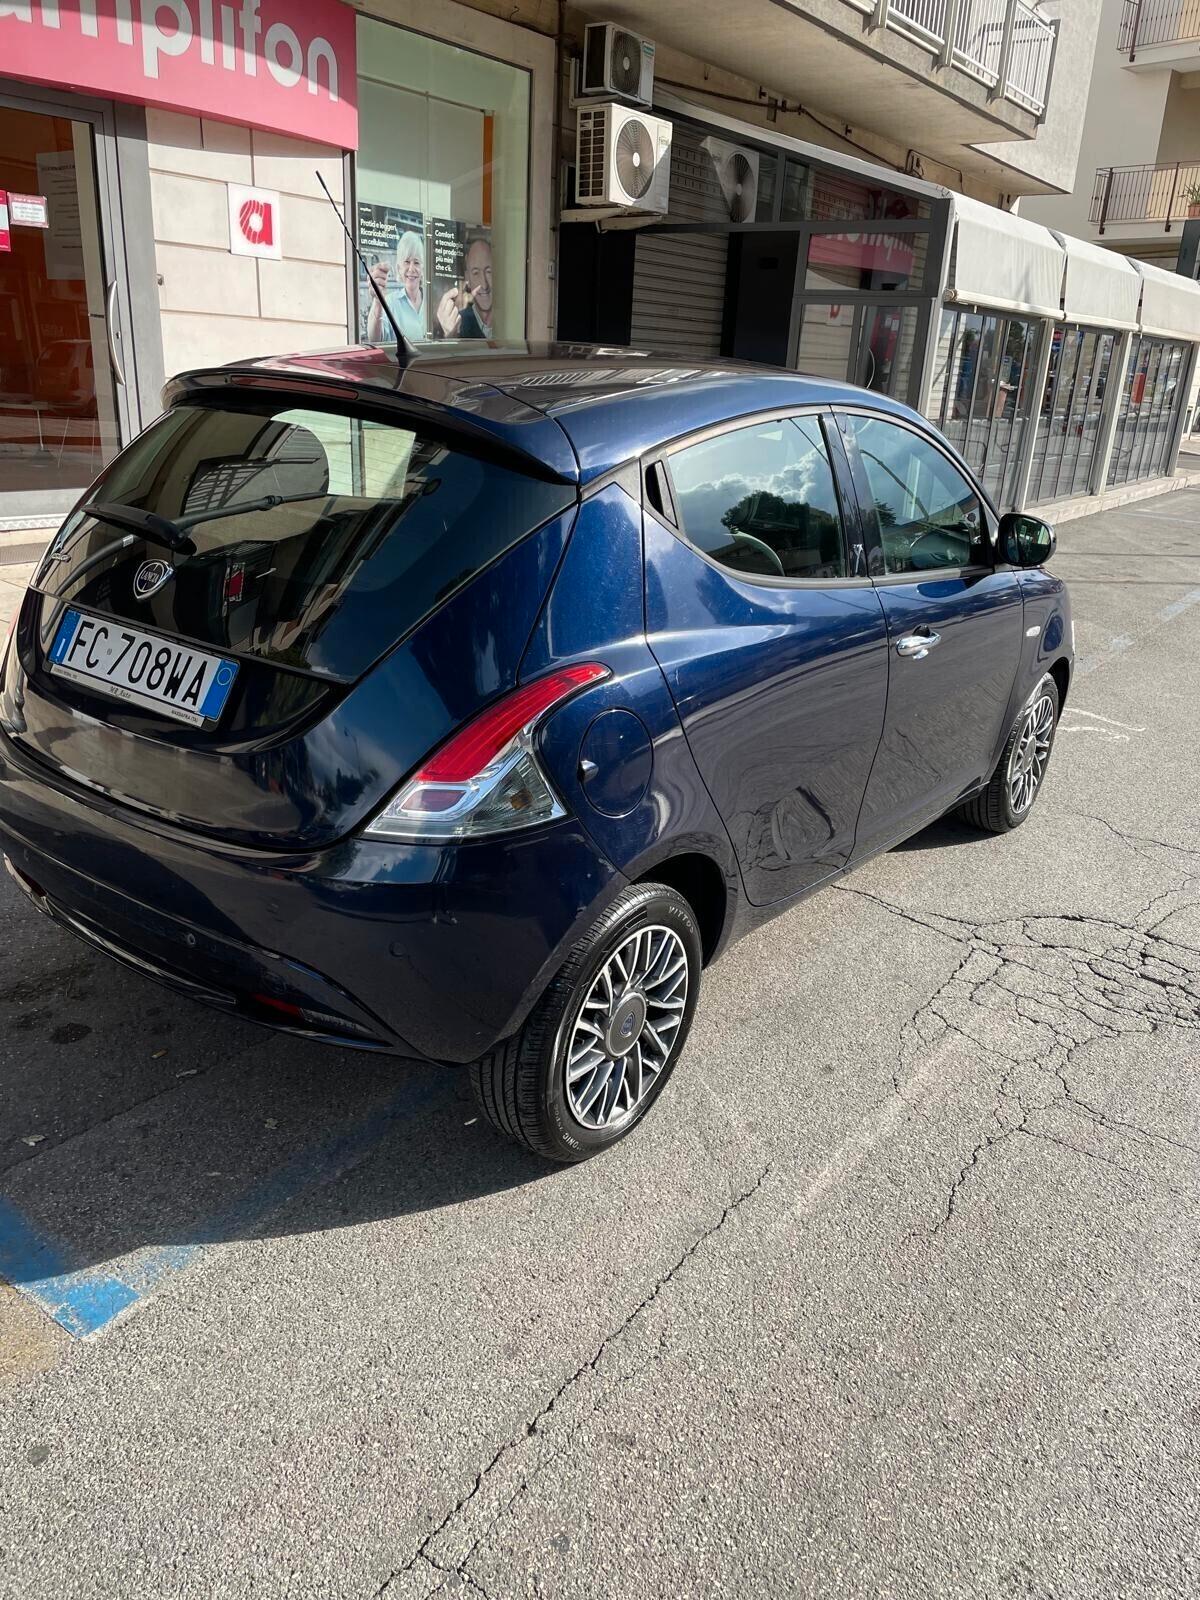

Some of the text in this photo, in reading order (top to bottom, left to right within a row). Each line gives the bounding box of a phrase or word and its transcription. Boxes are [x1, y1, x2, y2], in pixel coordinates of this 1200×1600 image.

[360, 218, 376, 227] Pratici
[360, 227, 400, 241] Ricaricabili come
[435, 229, 454, 239] Comfort
[439, 240, 463, 249] tecnologia
[435, 255, 454, 264] più mini
[435, 263, 445, 271] che
[67, 620, 208, 707] FC 708WA
